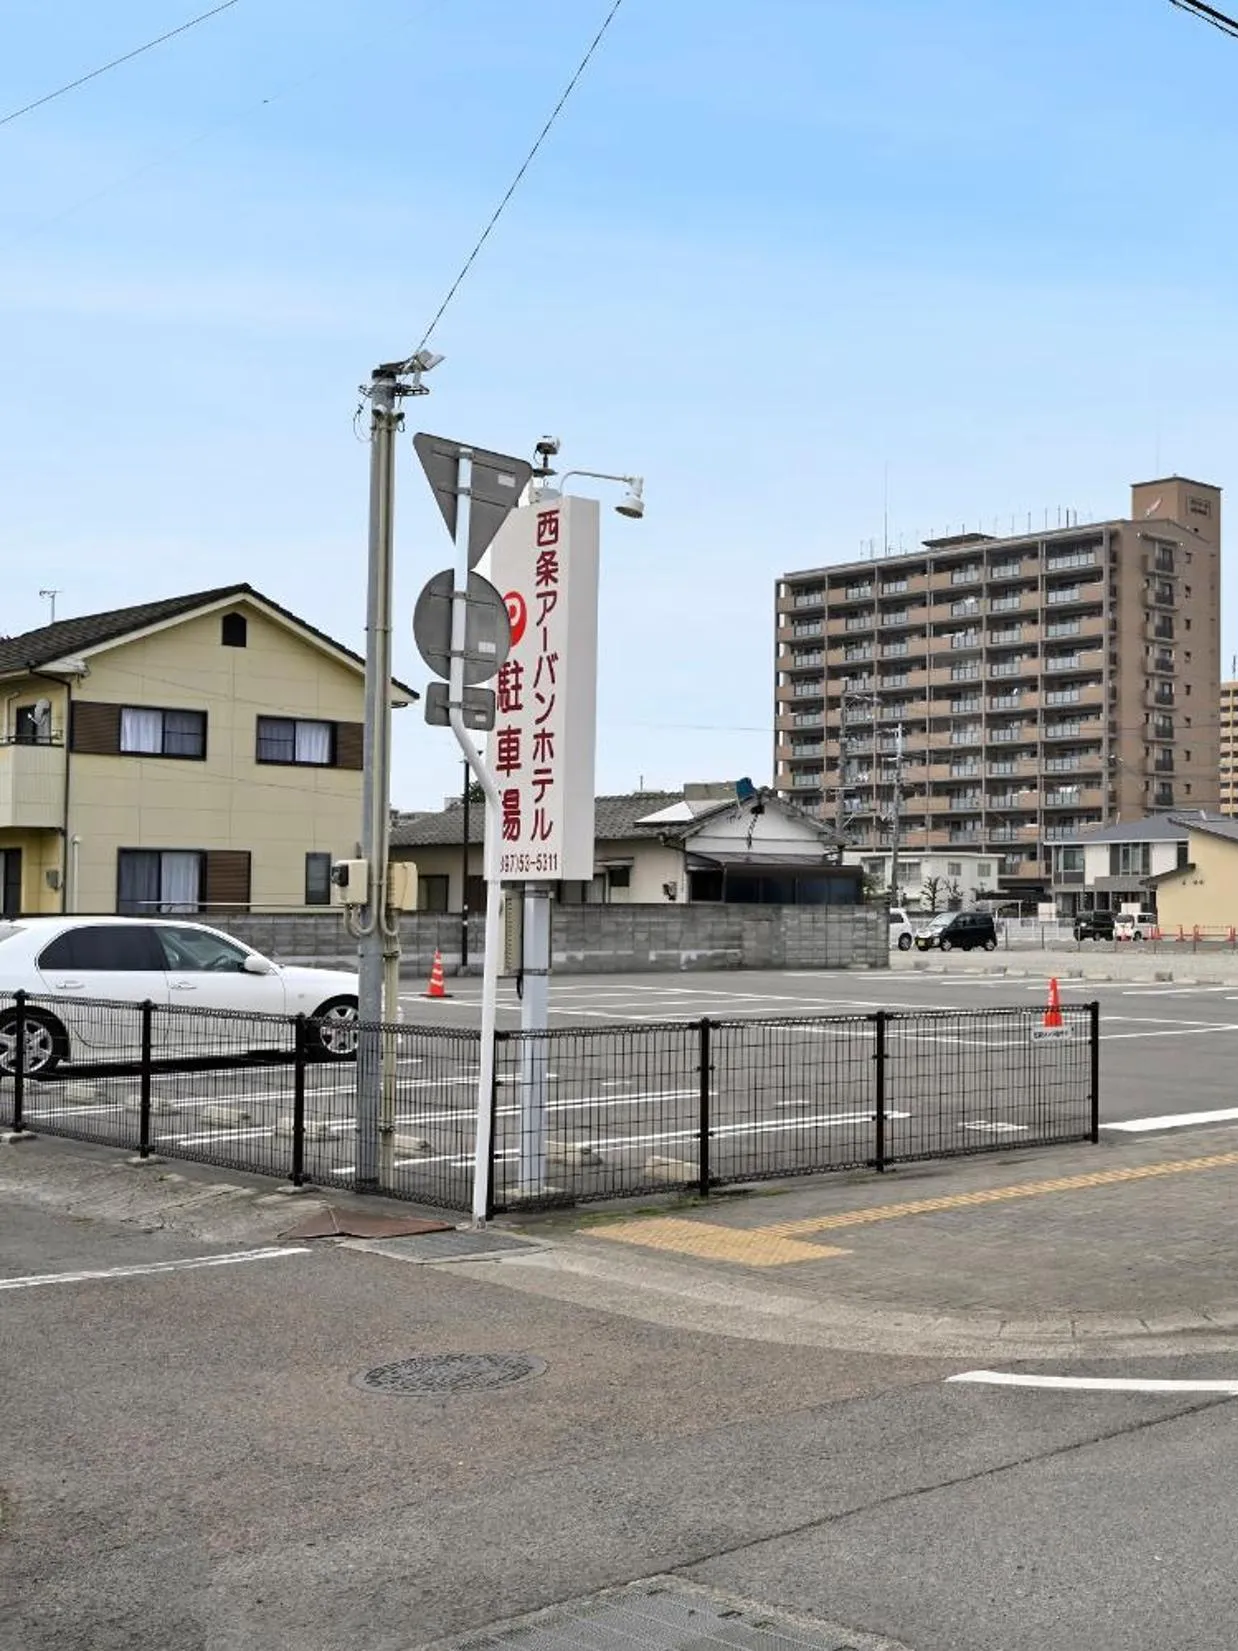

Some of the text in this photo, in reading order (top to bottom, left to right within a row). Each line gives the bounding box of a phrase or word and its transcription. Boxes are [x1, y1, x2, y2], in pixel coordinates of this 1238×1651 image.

[496, 660, 523, 842] 駐車場
[529, 509, 560, 842] 西条アーバンホテル
